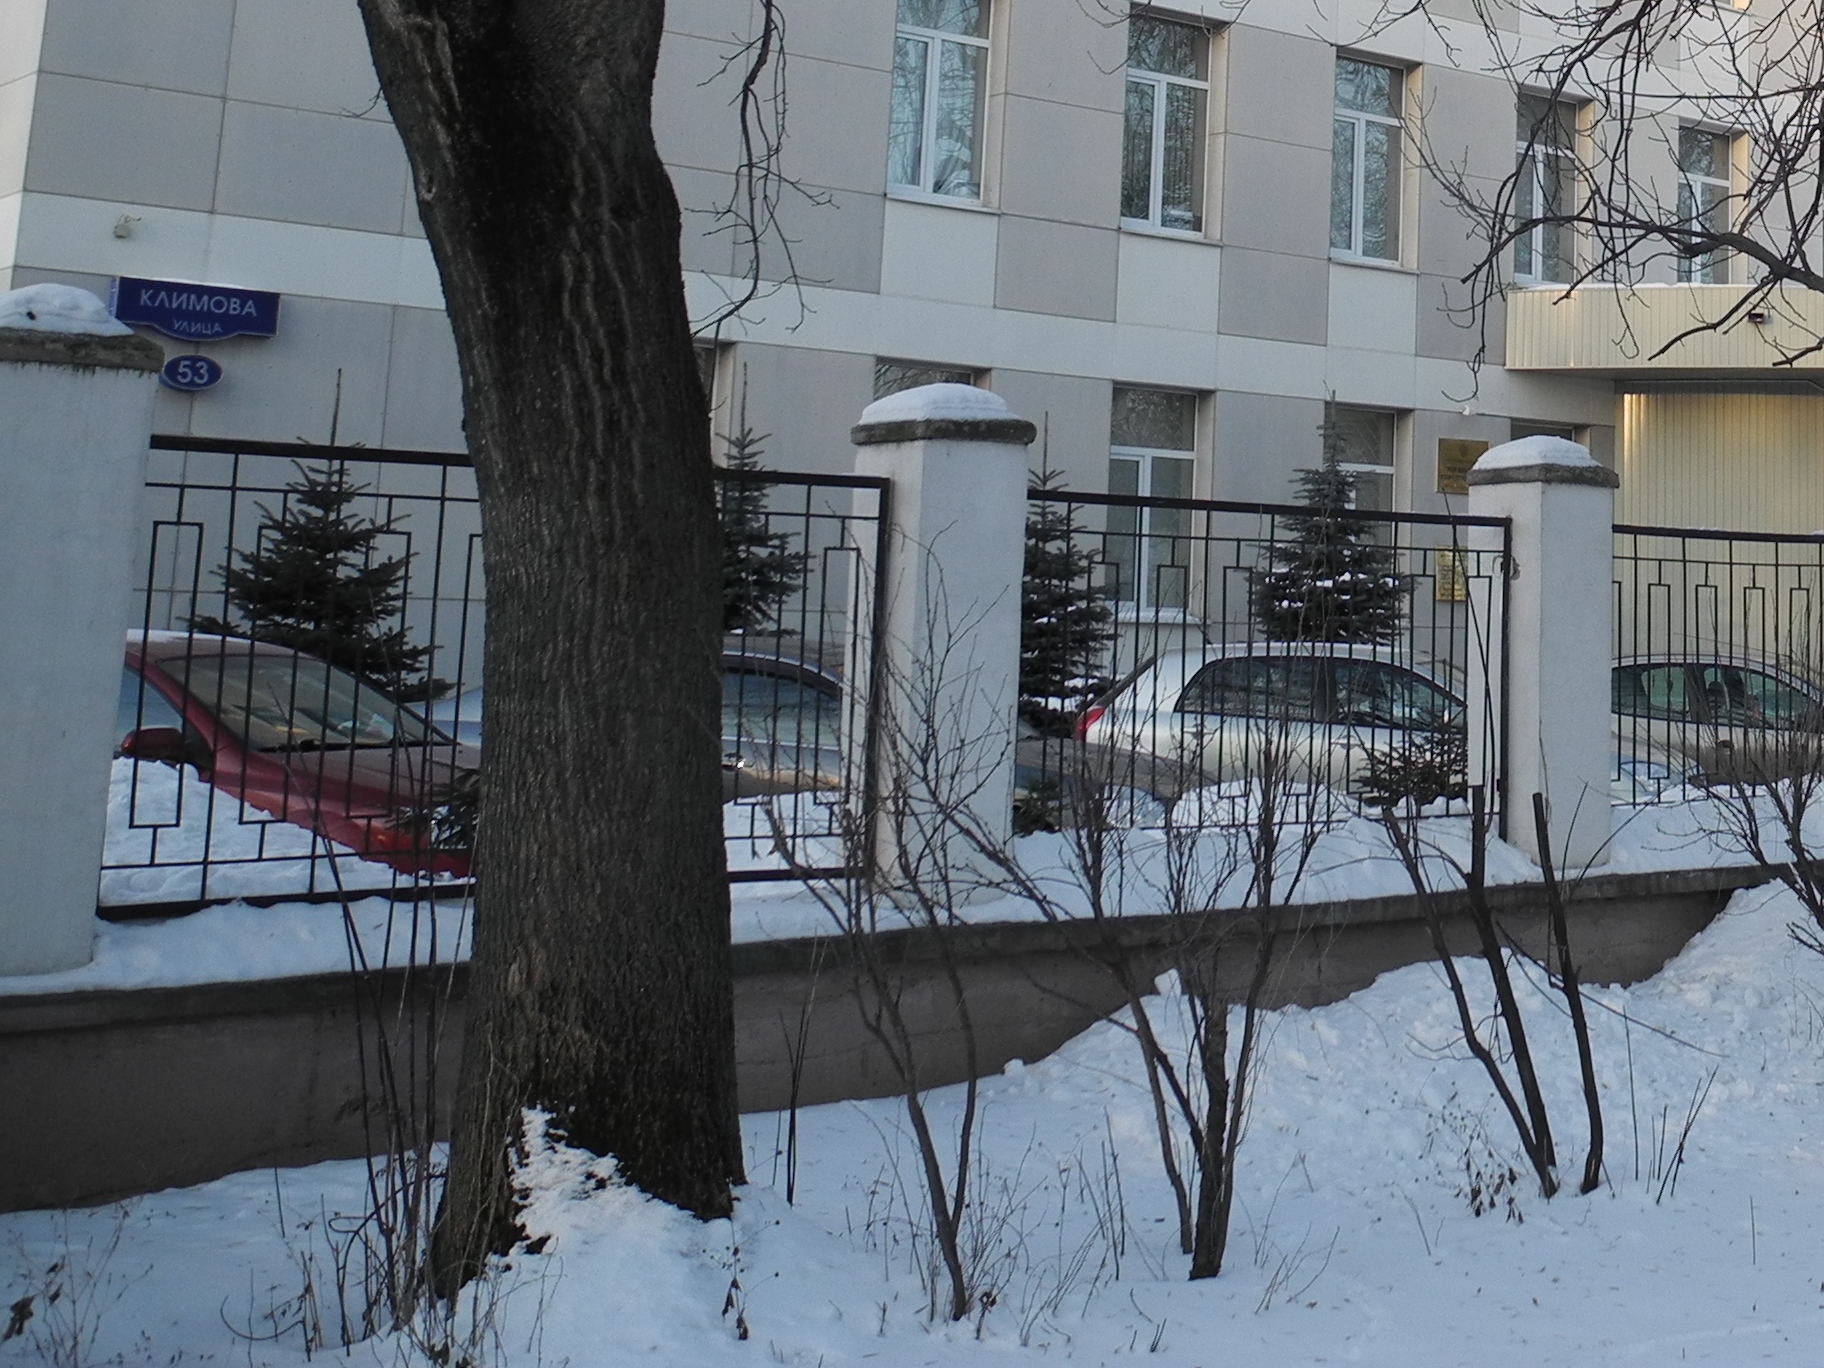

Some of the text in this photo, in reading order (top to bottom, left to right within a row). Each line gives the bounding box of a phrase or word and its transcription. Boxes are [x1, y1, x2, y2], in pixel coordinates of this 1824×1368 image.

[139, 288, 257, 317] КЛИМОВА
[173, 318, 223, 335] УЛИЦА
[177, 360, 209, 384] 53
